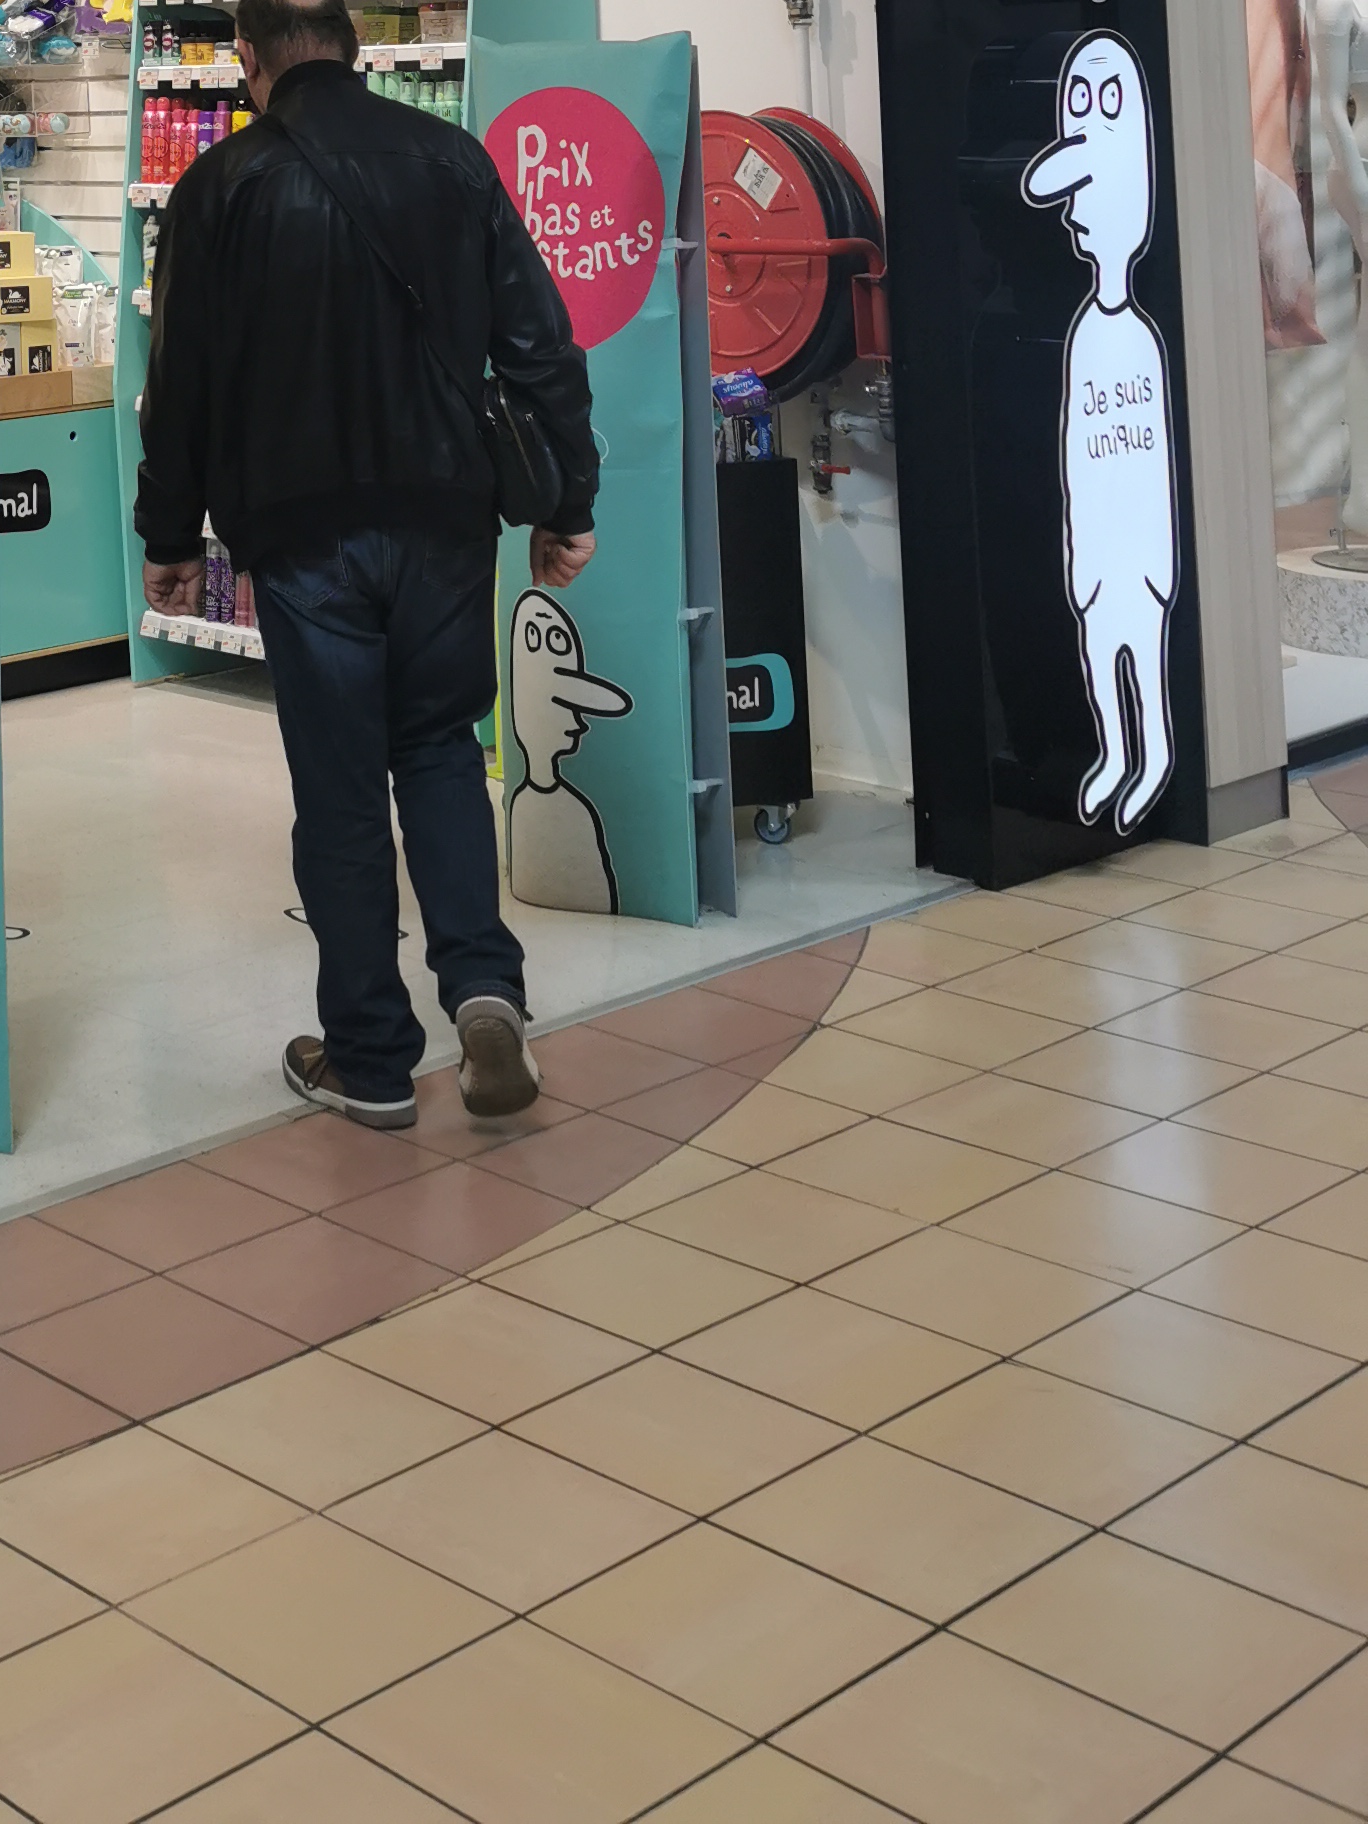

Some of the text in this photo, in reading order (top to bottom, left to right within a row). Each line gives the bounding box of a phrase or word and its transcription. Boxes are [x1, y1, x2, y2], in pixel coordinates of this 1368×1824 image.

[517, 124, 593, 199] Prix
[523, 181, 615, 240] bas et
[537, 219, 654, 282] stants
[1083, 374, 1153, 417] Je suis
[1087, 424, 1155, 460] unique
